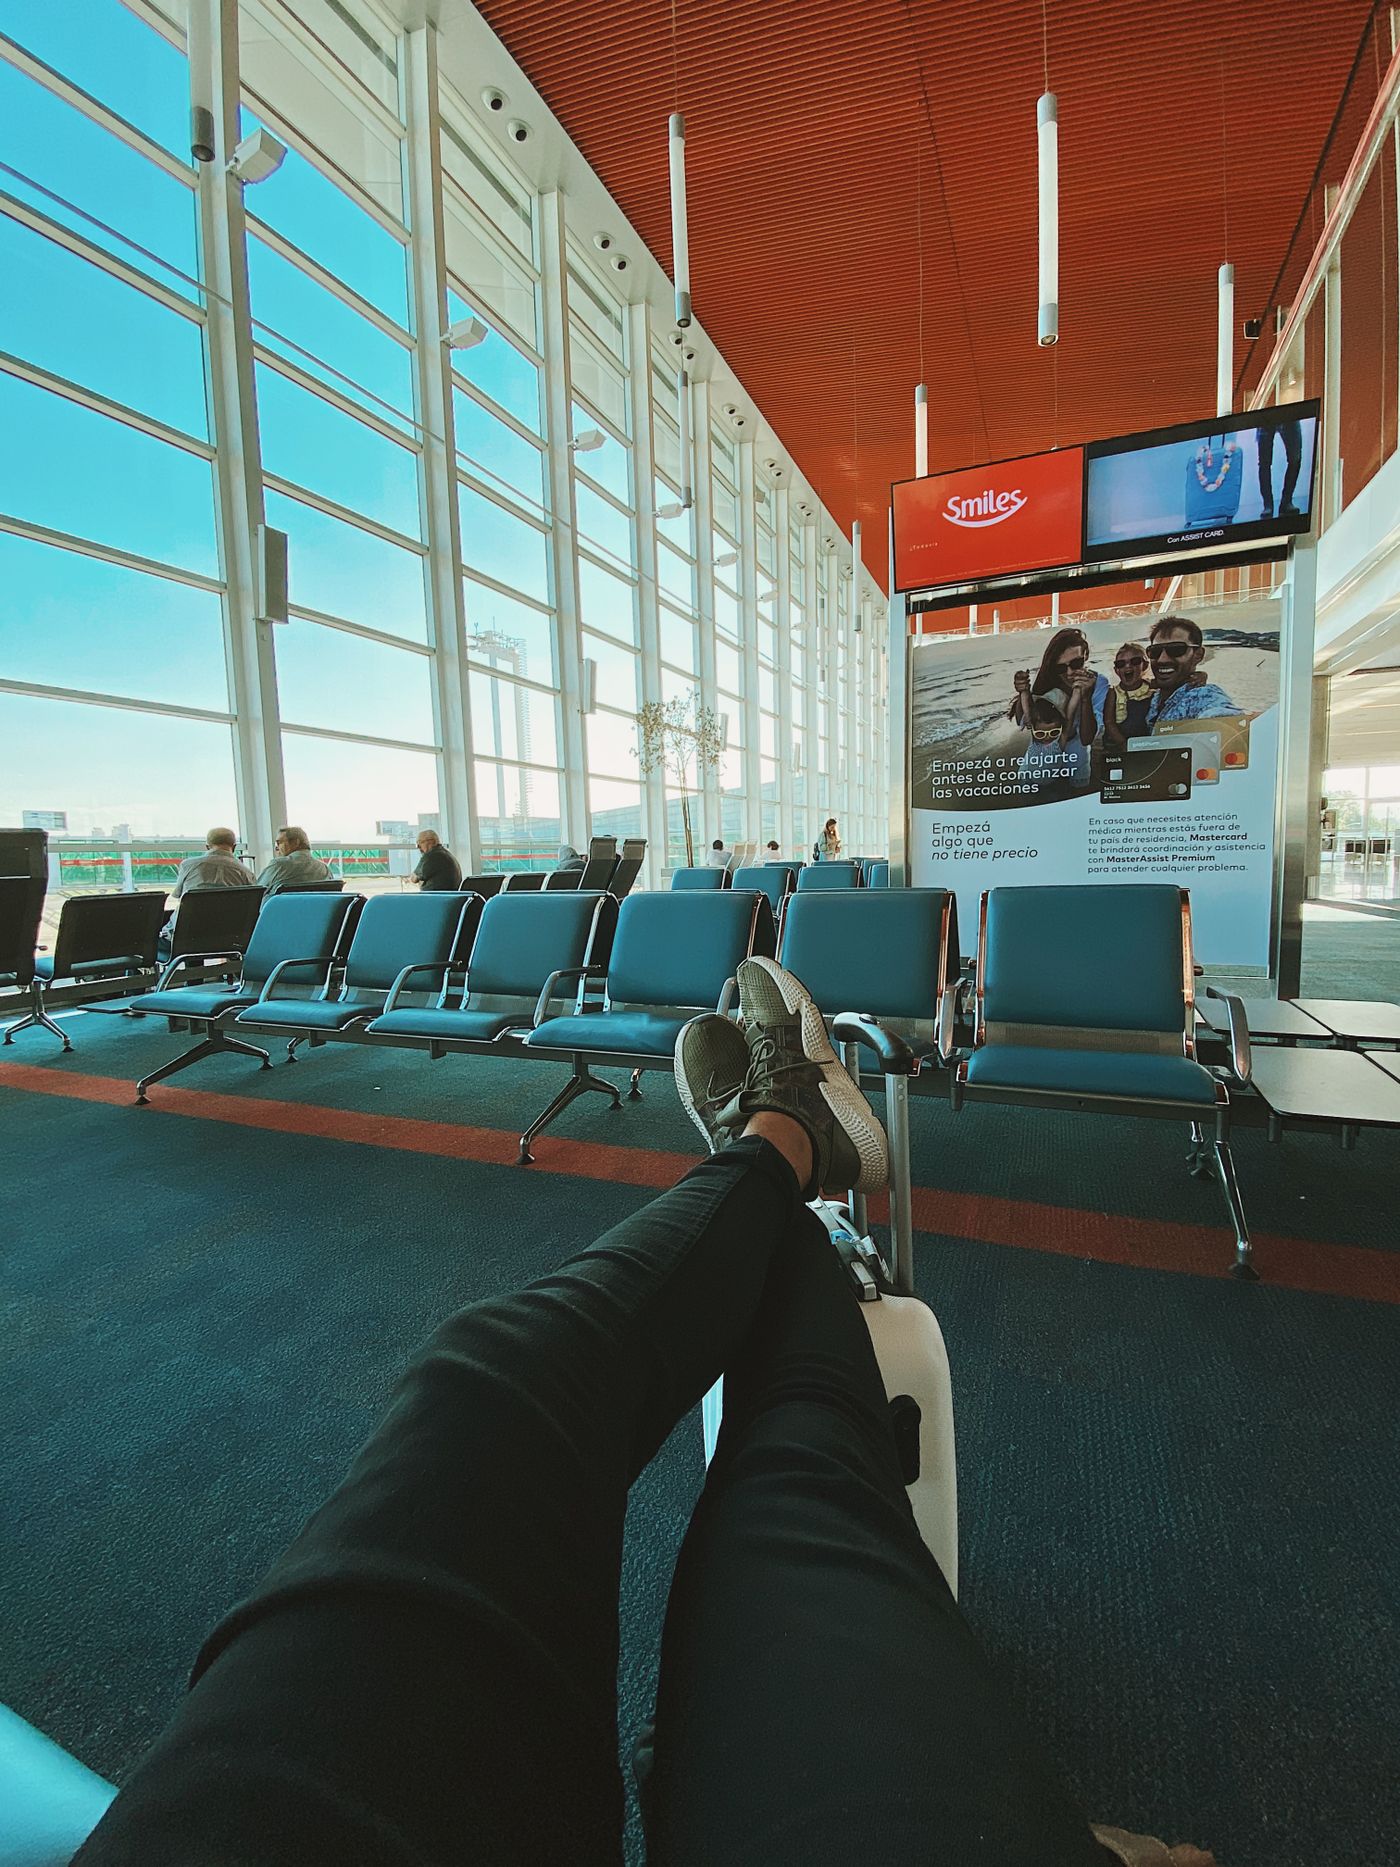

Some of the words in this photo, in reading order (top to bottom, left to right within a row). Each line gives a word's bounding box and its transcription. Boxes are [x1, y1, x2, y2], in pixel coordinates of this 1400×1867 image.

[946, 489, 1022, 521] Smiles
[1180, 533, 1204, 542] ASSIST
[932, 756, 991, 773] Empezá
[996, 758, 1006, 768] a
[1010, 751, 1078, 768] relajarte
[932, 774, 972, 786] antes
[977, 770, 995, 782] de
[1000, 767, 1078, 781] comenzar
[932, 786, 952, 799] las
[956, 783, 1039, 797] vacaciones
[1147, 815, 1191, 823] necesites
[1194, 813, 1238, 821] atención
[932, 820, 990, 836] Empezá
[1088, 827, 1122, 835] médica
[1228, 823, 1240, 831] de
[932, 836, 962, 850] algo
[967, 837, 993, 849] que
[1100, 837, 1120, 845] país
[1136, 835, 1187, 843] residencia,
[1190, 833, 1248, 841] Mastercard
[932, 851, 949, 861] no
[954, 849, 988, 860] tiene
[992, 846, 1038, 861] precio
[1100, 846, 1140, 854] brindará
[1142, 844, 1204, 852] coordinación
[1215, 843, 1266, 851] asistencia
[1106, 855, 1169, 863] MasterAssist
[1172, 854, 1215, 862] Premium
[1151, 864, 1196, 873] cualquier
[1198, 864, 1248, 873] problema.
